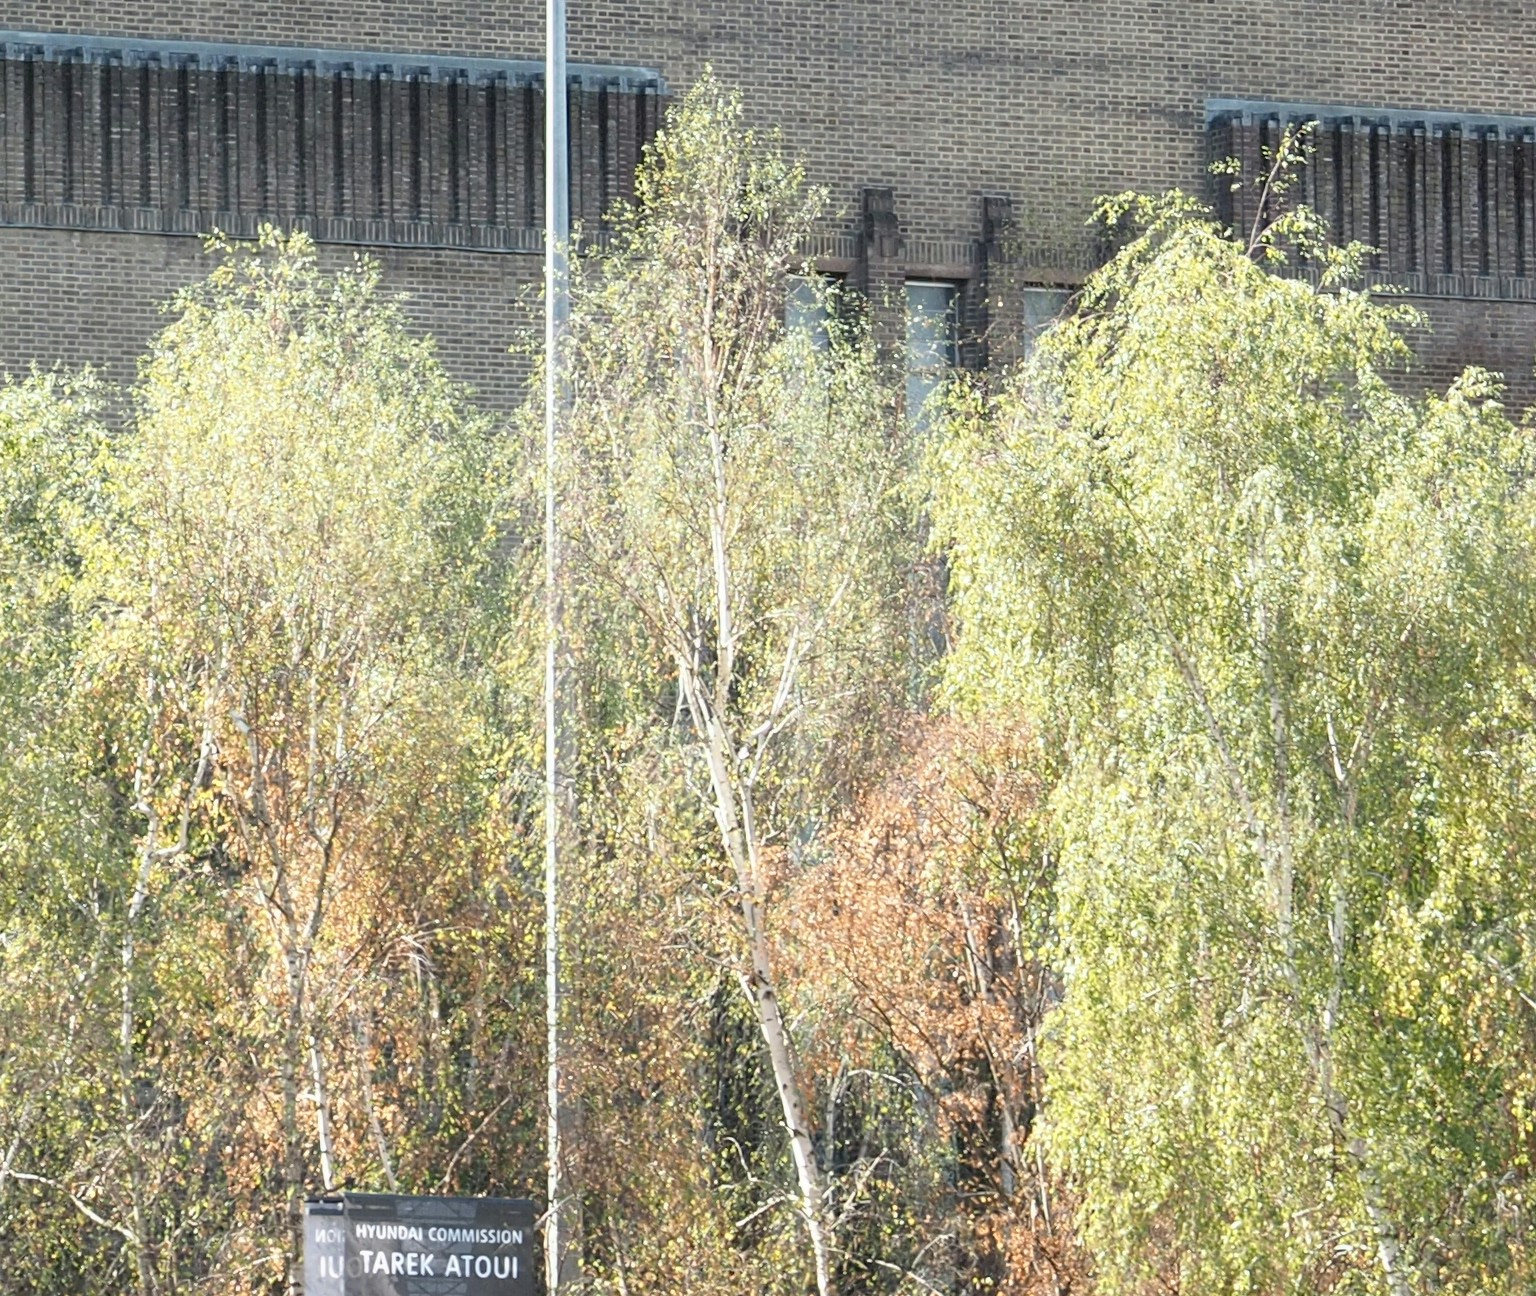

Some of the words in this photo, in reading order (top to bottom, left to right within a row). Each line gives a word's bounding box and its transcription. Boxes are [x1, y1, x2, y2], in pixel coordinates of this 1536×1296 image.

[356, 1223, 423, 1241] HYUNDAI
[428, 1226, 523, 1244] COMMISSION
[359, 1249, 435, 1277] TAREK
[445, 1254, 518, 1280] ATOUI
